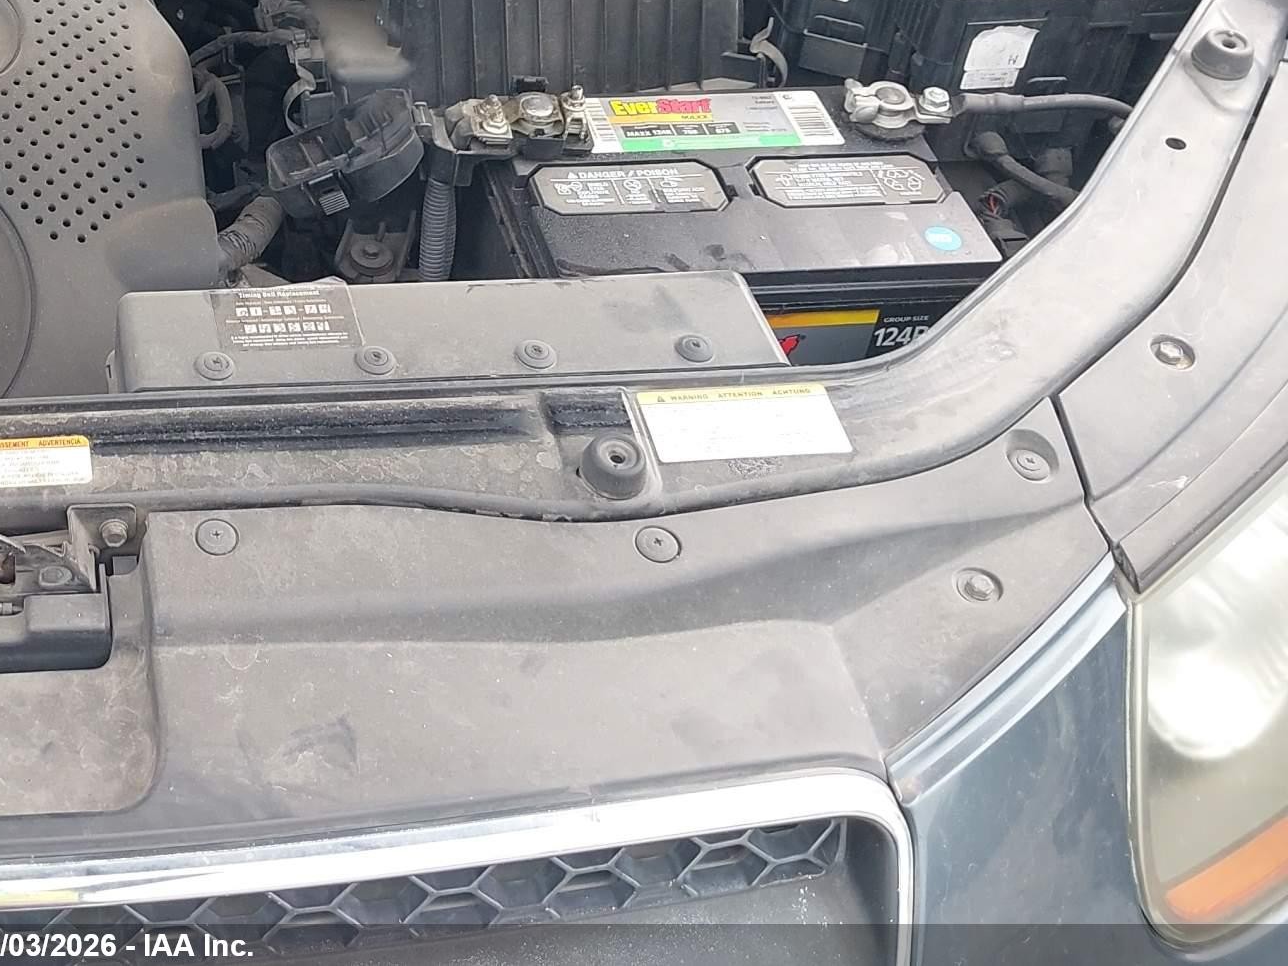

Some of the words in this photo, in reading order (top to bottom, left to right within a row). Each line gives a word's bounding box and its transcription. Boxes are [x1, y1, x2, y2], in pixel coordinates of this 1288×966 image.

[609, 98, 711, 116] EverStart
[578, 170, 625, 179] DANGER
[637, 168, 679, 177] POISON
[670, 392, 708, 401] WARNING
[718, 390, 763, 399] ATTENTION
[772, 387, 811, 395] ACHTUNG
[38, 437, 82, 447] ADVERTENCIA
